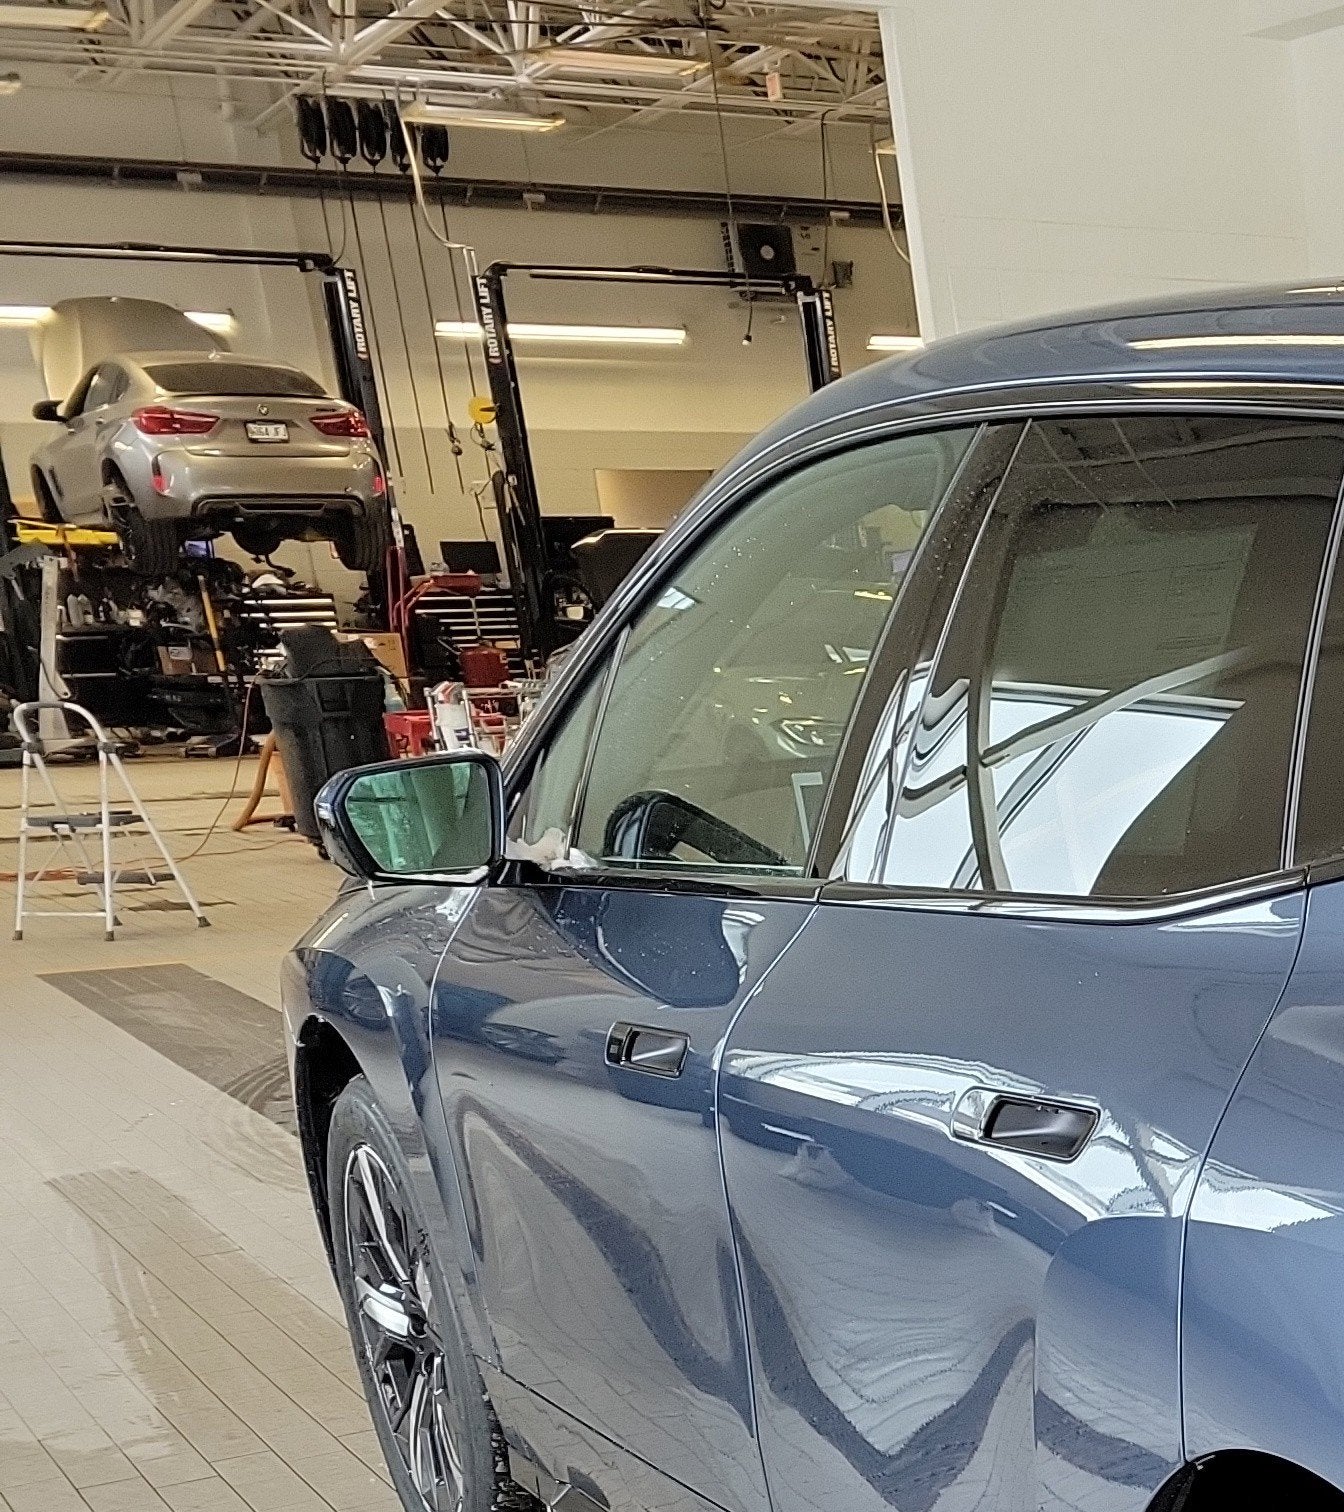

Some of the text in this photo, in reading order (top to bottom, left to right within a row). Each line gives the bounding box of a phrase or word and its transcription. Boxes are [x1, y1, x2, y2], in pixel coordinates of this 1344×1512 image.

[343, 269, 367, 352] ROTARY LIFT
[476, 276, 500, 357] ROTARY LIFT
